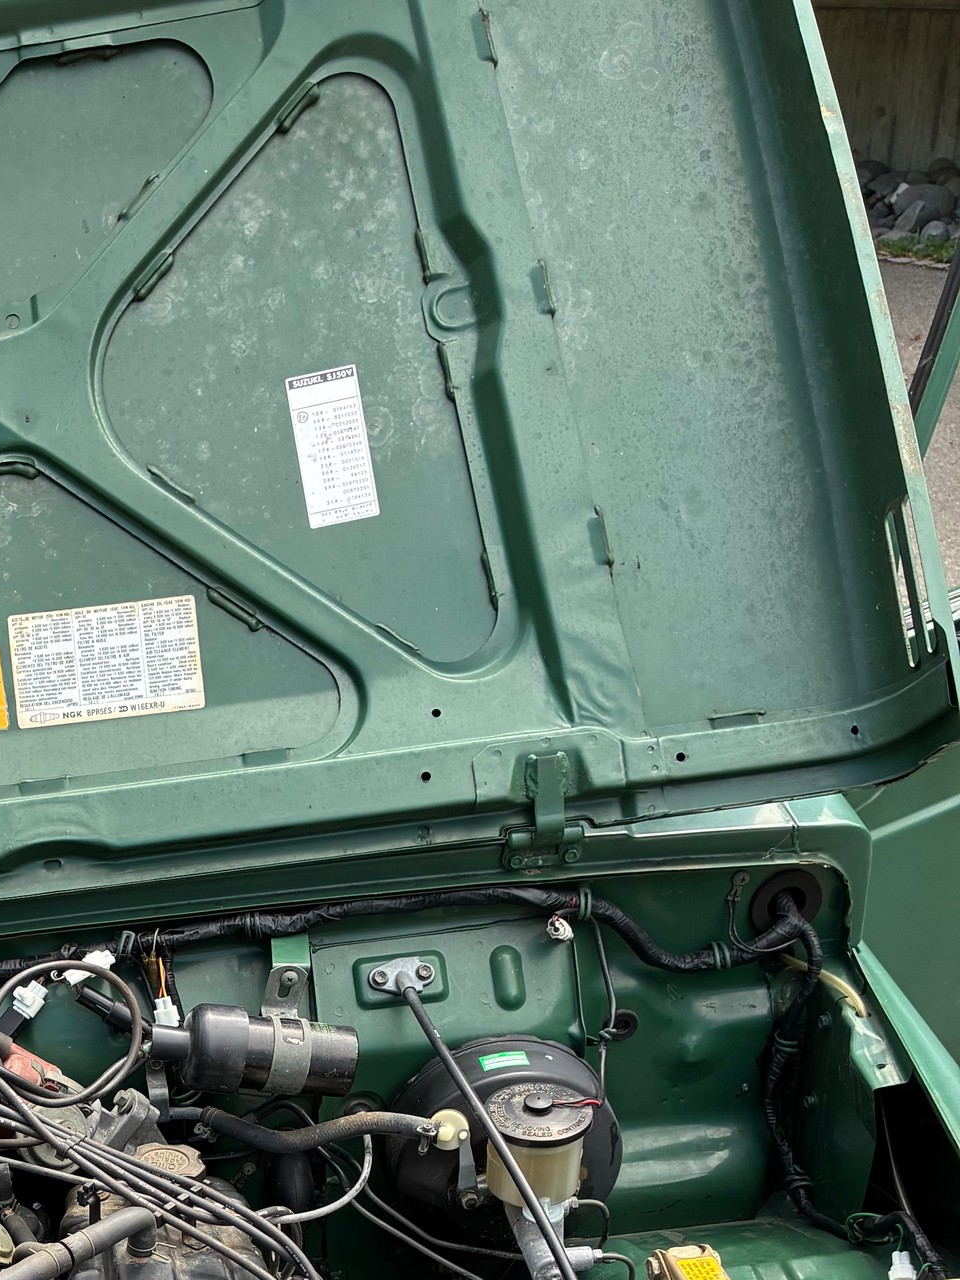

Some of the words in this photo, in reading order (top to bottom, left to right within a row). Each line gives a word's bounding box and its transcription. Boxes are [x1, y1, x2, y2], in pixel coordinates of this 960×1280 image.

[325, 368, 353, 380] SJ50V
[62, 710, 82, 719] NGK
[130, 700, 165, 711] W16EXR-U
